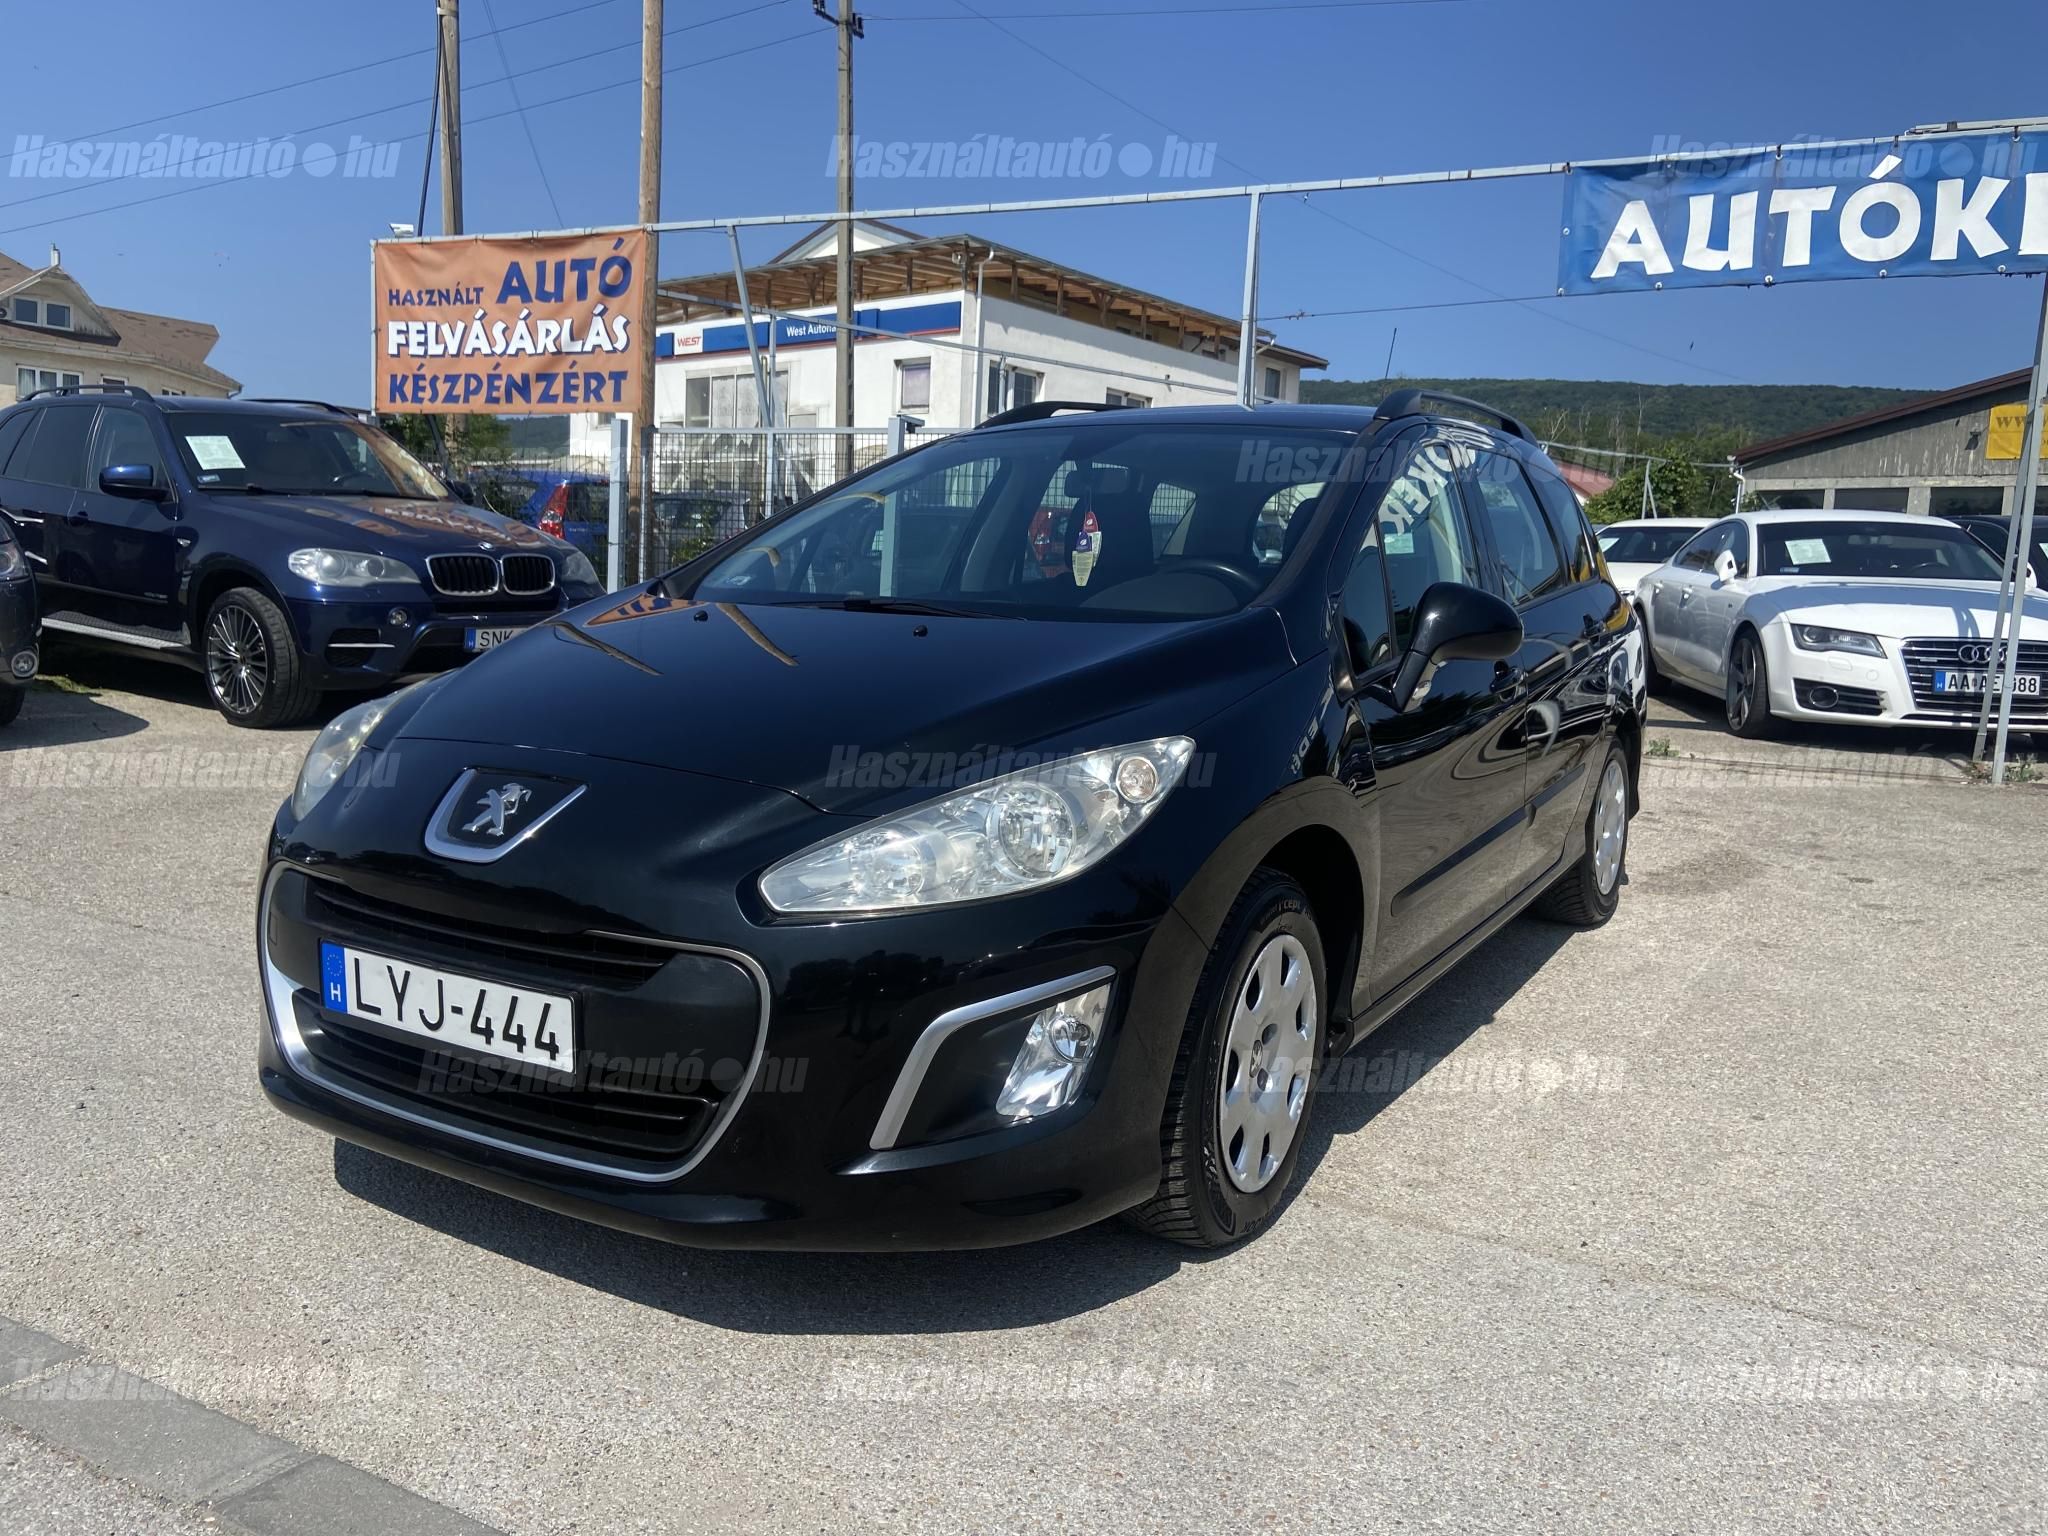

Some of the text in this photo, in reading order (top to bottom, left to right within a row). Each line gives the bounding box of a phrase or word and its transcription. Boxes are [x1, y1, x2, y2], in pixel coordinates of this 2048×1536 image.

[388, 237, 633, 306] HASZNÁLT AUTÓ
[387, 303, 631, 358] FELVÁSÁRLÁS
[677, 335, 702, 347] WEST
[786, 325, 806, 338] West
[389, 360, 629, 405] KÉSZPÉNZÉRT
[353, 957, 560, 1061] LYJ-444
